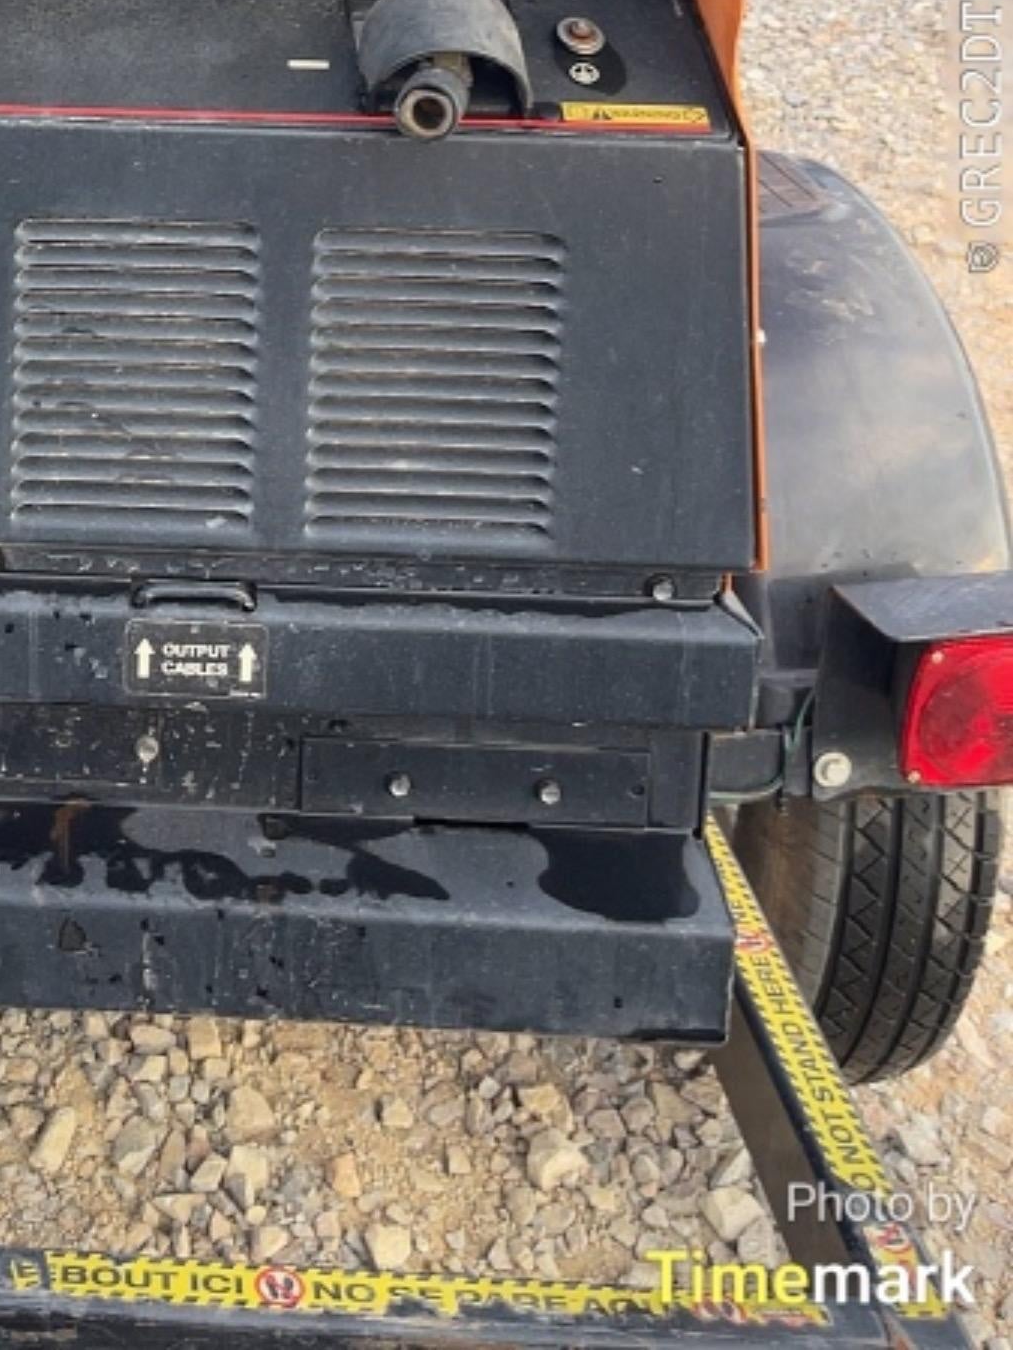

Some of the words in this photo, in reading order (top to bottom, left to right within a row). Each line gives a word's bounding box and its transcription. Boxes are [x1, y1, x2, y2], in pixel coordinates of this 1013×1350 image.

[162, 642, 231, 659] OUTPUT
[161, 660, 228, 677] CABLES
[751, 955, 796, 1015] HERE
[783, 1021, 837, 1103] STAND
[190, 1272, 244, 1295] ICI
[312, 1280, 377, 1303] NO
